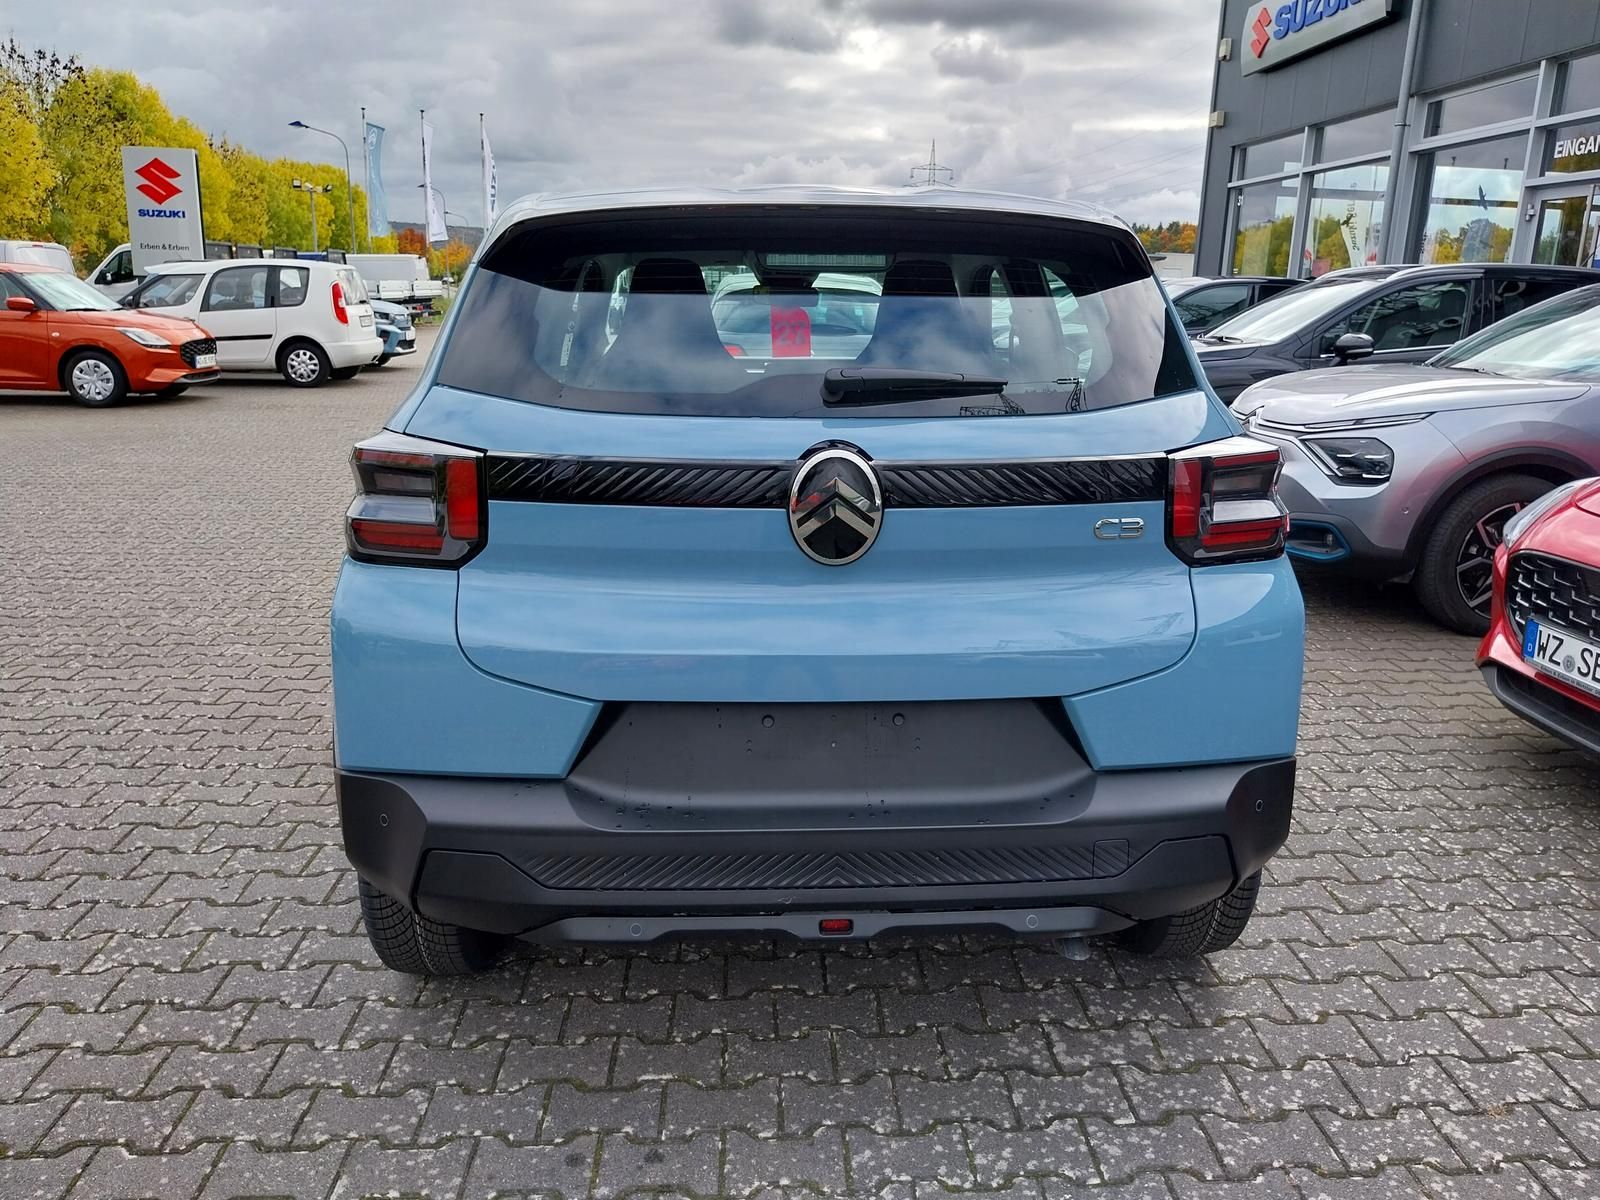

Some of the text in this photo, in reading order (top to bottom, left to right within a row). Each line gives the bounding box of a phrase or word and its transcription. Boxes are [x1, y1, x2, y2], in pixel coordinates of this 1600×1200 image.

[138, 209, 186, 219] SUZUKI
[1094, 517, 1144, 540] C3
[1527, 643, 1533, 652] D
[1537, 629, 1564, 667] WZ
